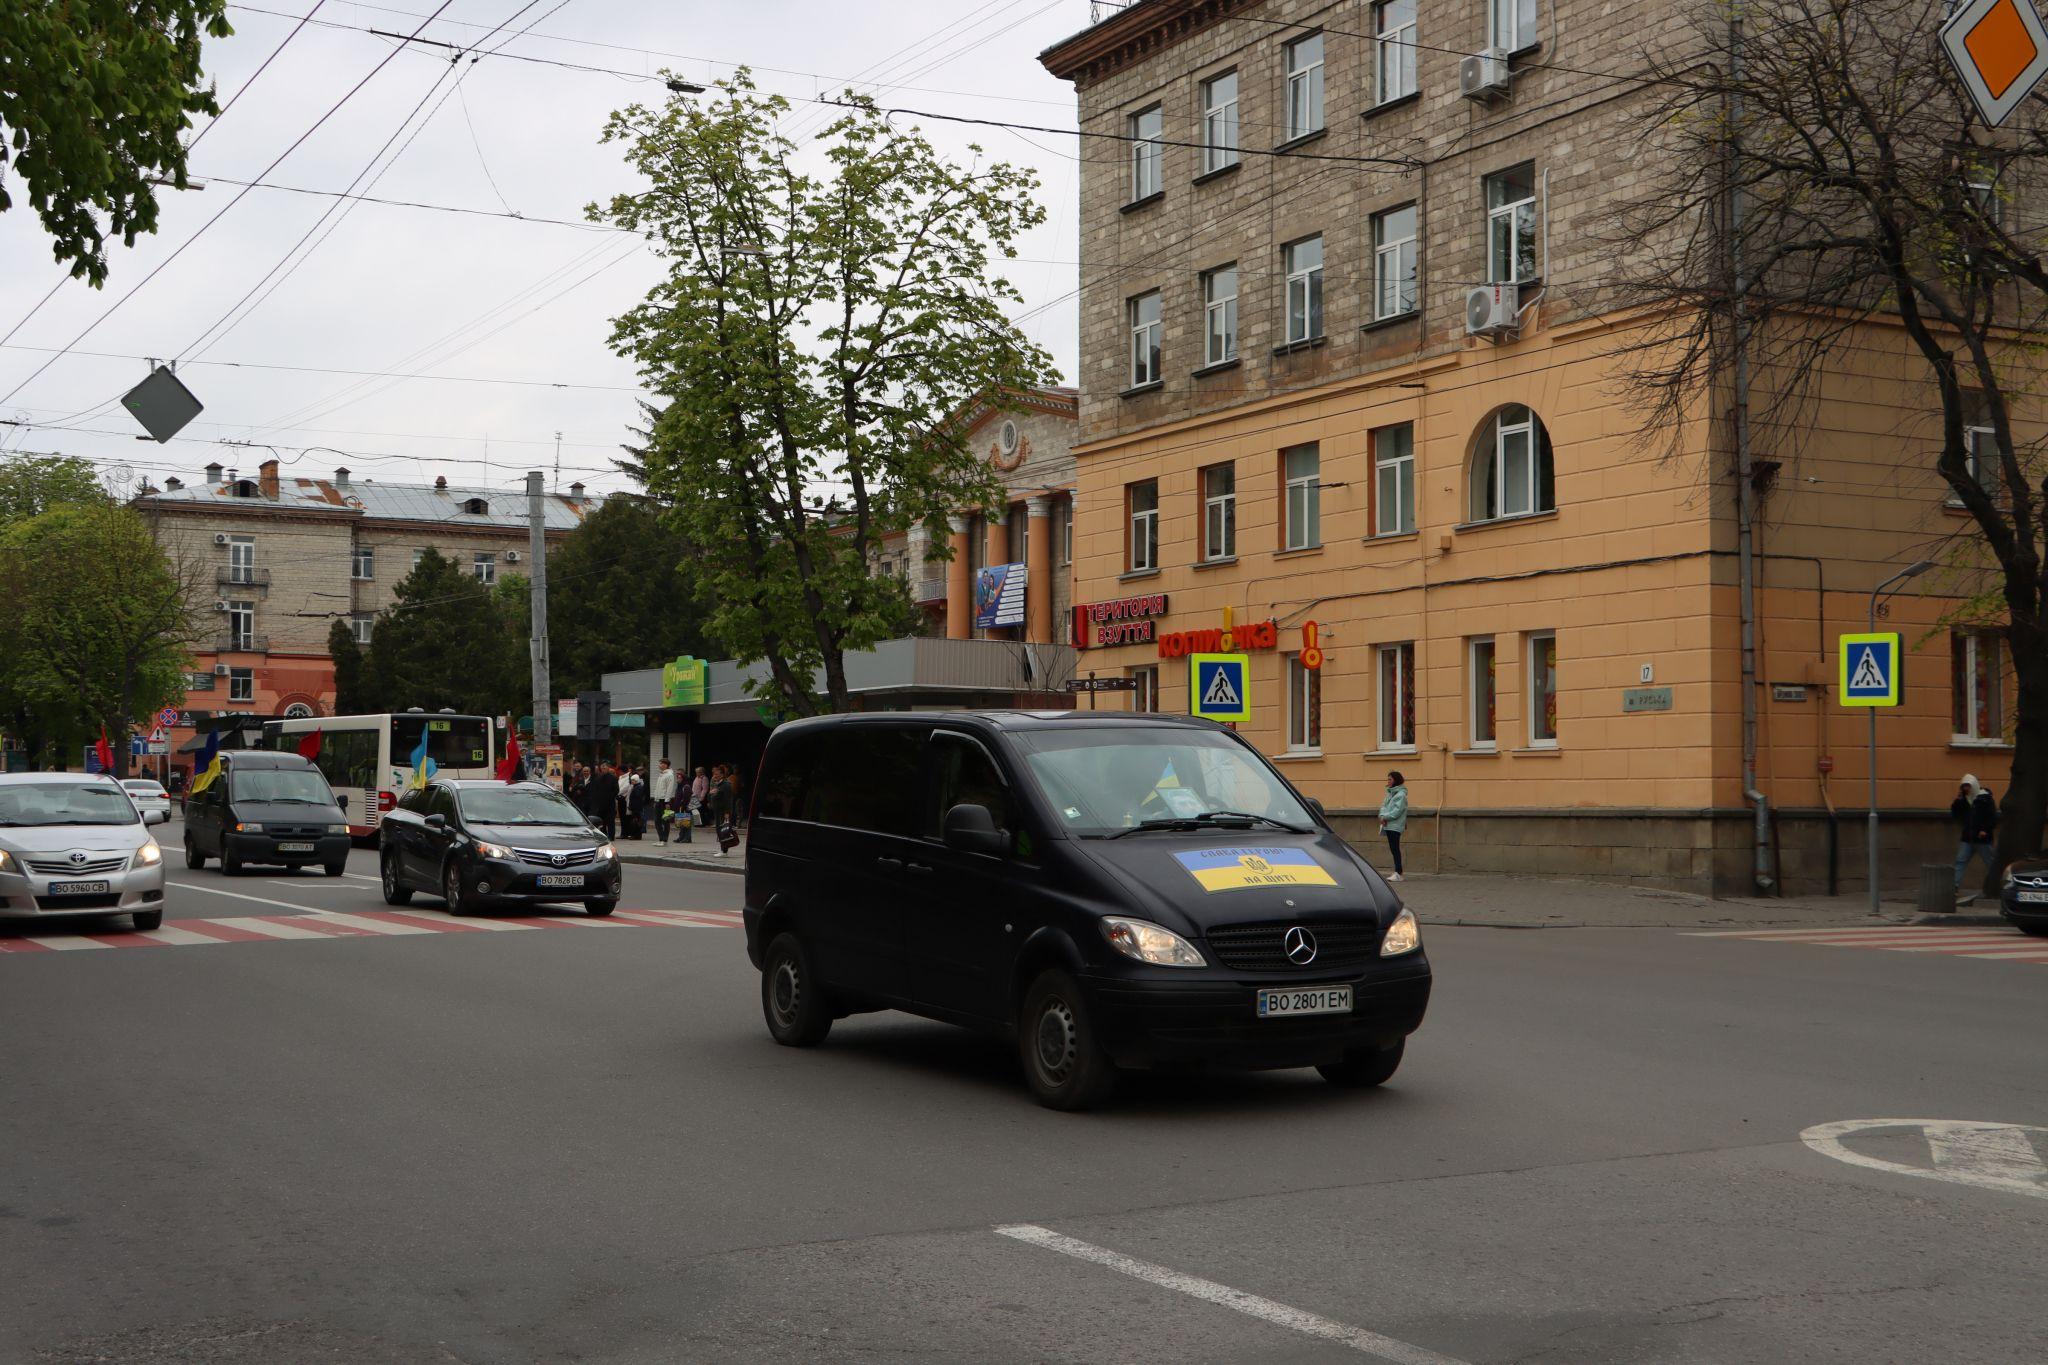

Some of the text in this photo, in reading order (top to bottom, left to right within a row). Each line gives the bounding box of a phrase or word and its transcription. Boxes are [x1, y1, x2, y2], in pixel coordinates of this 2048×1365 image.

[1087, 596, 1163, 622] ТЕРИТОРІЯ
[1097, 620, 1151, 645] ВЗУТТЯ
[1643, 667, 1650, 679] 17
[435, 722, 444, 730] 16
[474, 751, 483, 760] 16
[542, 877, 552, 885] BO
[573, 877, 582, 885] EC
[1244, 875, 1262, 884] НА
[57, 885, 68, 893] BO
[93, 884, 104, 892] CB
[1269, 990, 1348, 1011] BO 2801 EM
